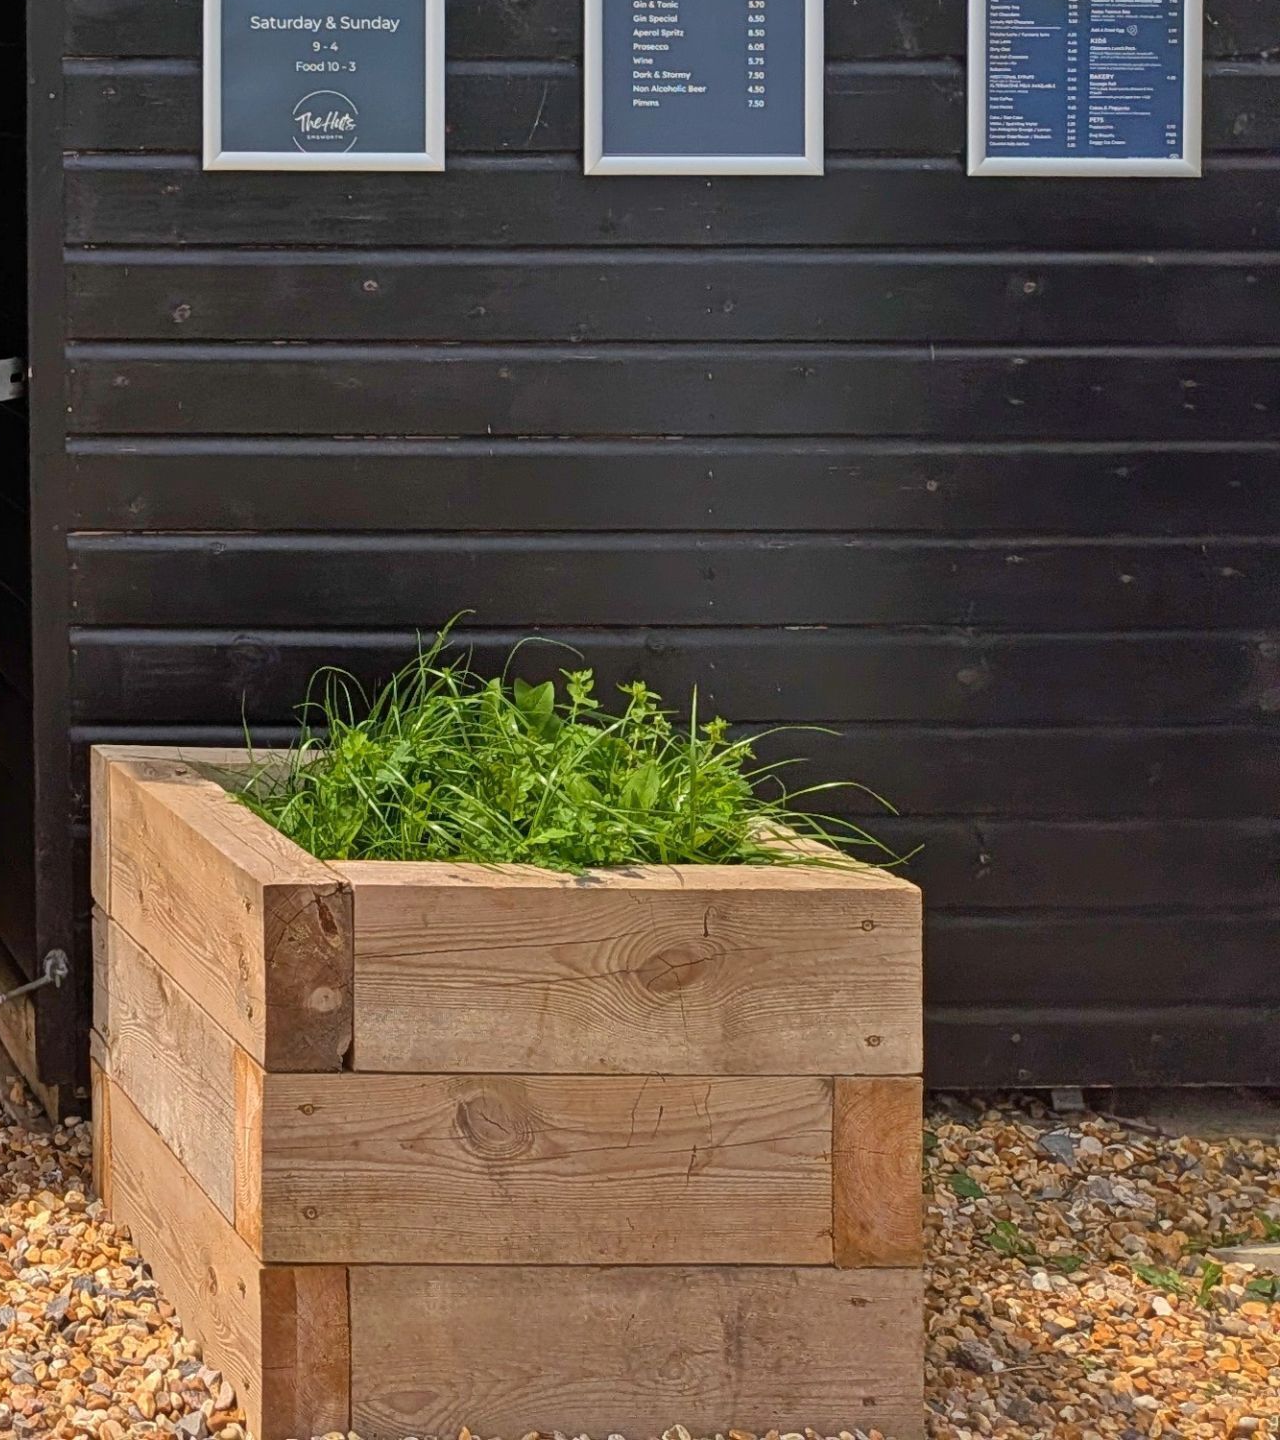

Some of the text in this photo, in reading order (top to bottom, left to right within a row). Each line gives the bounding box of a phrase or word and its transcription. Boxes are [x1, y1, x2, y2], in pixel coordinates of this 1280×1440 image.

[251, 16, 400, 32] Saturday & Sunday
[649, 15, 678, 24] Special
[633, 29, 684, 38] Aperol Spritz
[313, 42, 320, 51] 9
[330, 42, 338, 51] 4
[296, 61, 324, 71] Food
[328, 62, 339, 71] 10
[349, 62, 356, 71] 3
[633, 71, 652, 79] Dark
[654, 71, 660, 79] &
[748, 71, 764, 79] 7.50
